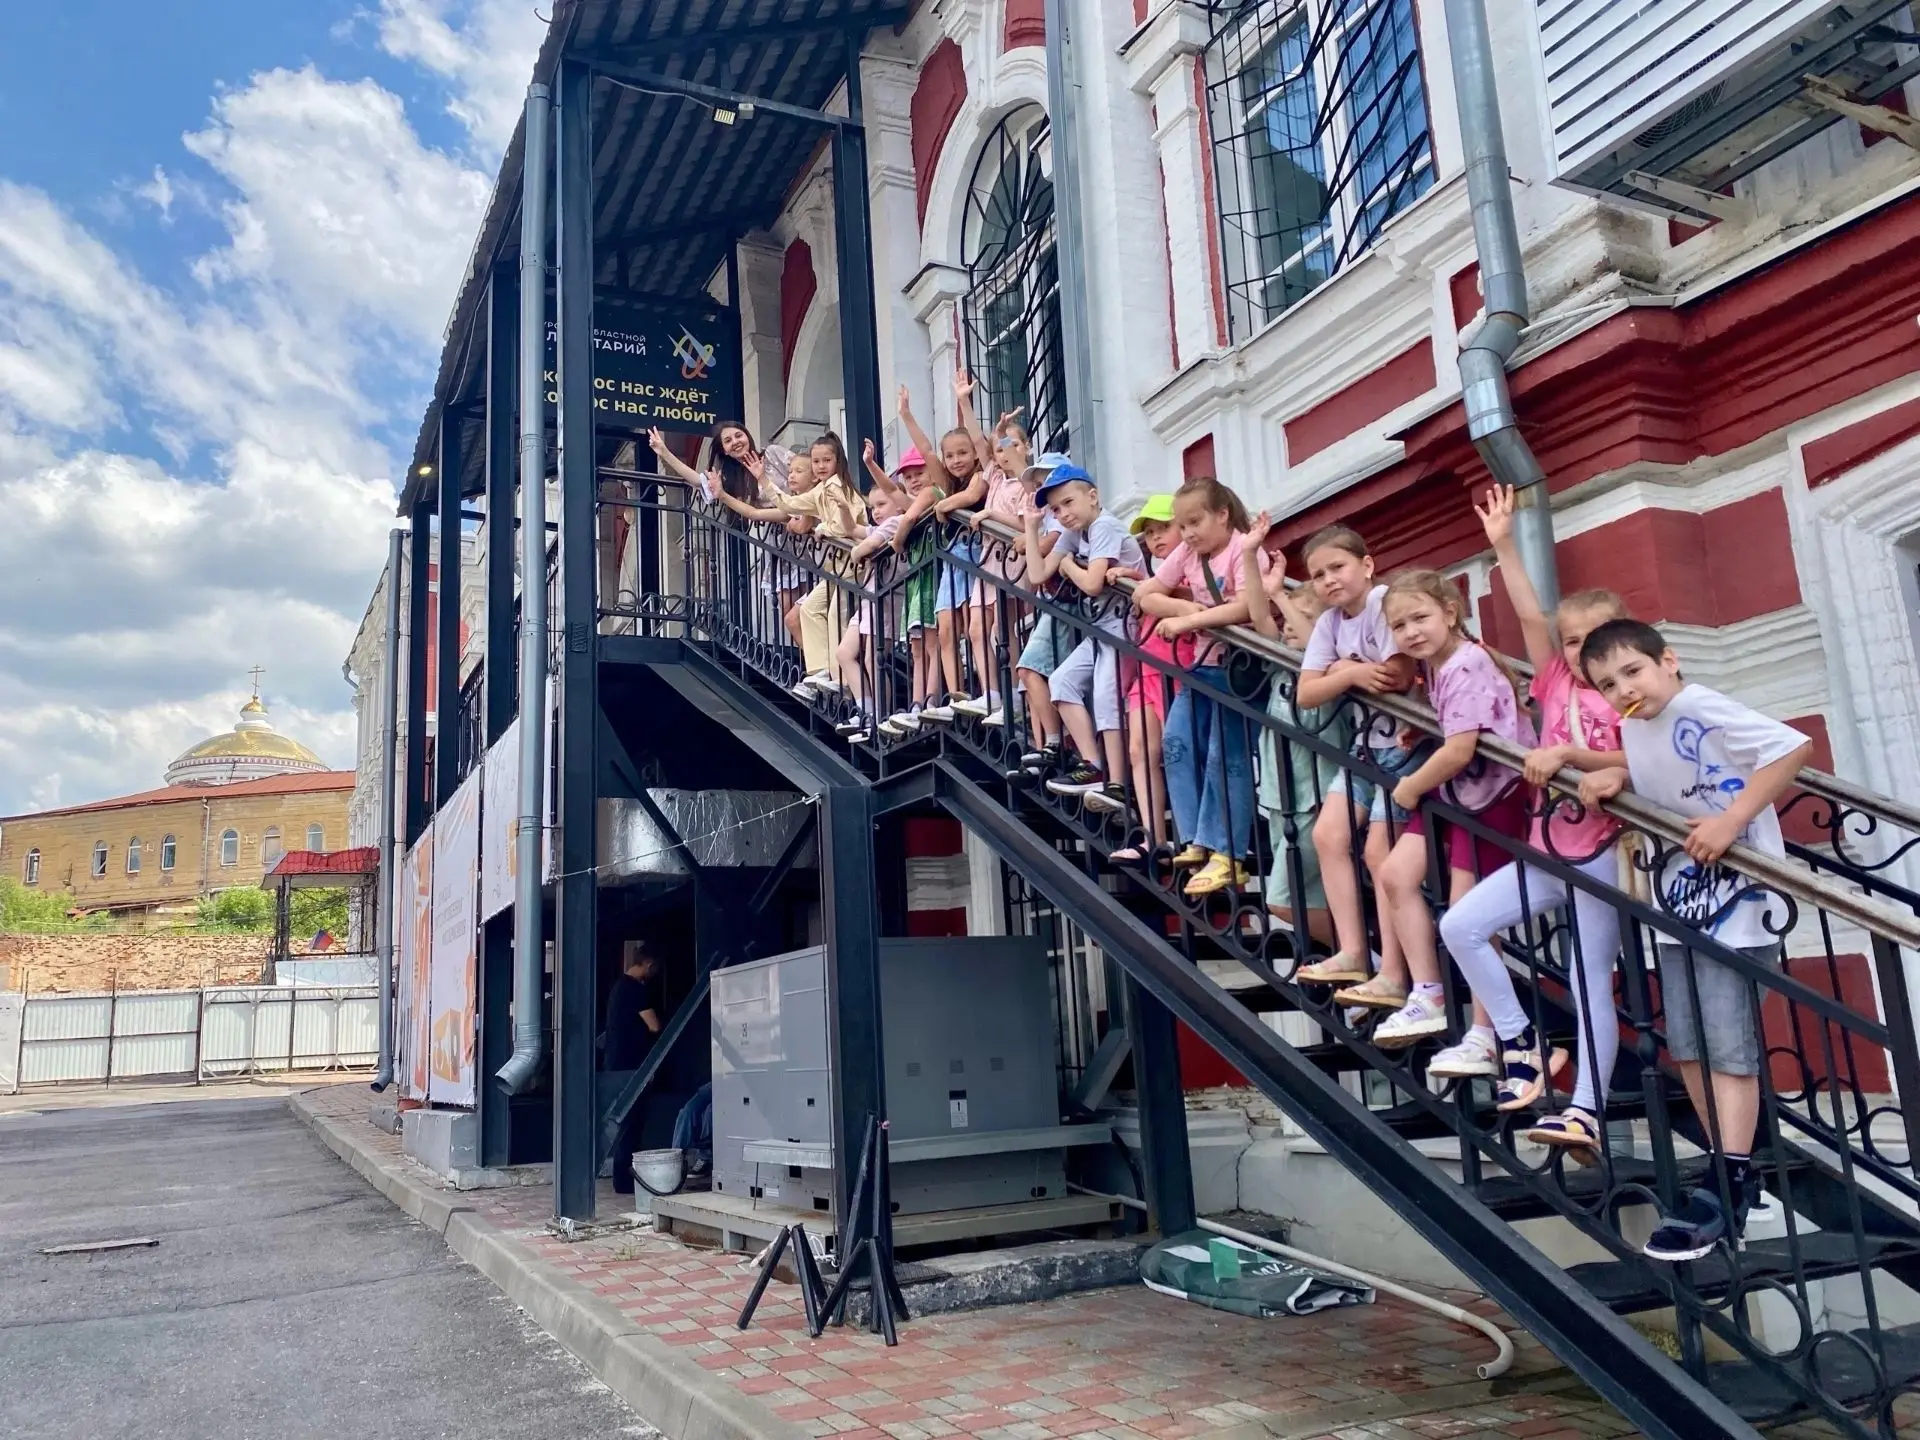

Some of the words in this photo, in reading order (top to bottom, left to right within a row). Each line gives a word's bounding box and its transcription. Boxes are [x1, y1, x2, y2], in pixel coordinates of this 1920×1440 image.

[621, 381, 654, 397] нас
[659, 386, 710, 404] ждёт
[614, 400, 648, 415] нас
[653, 405, 717, 425] любит
